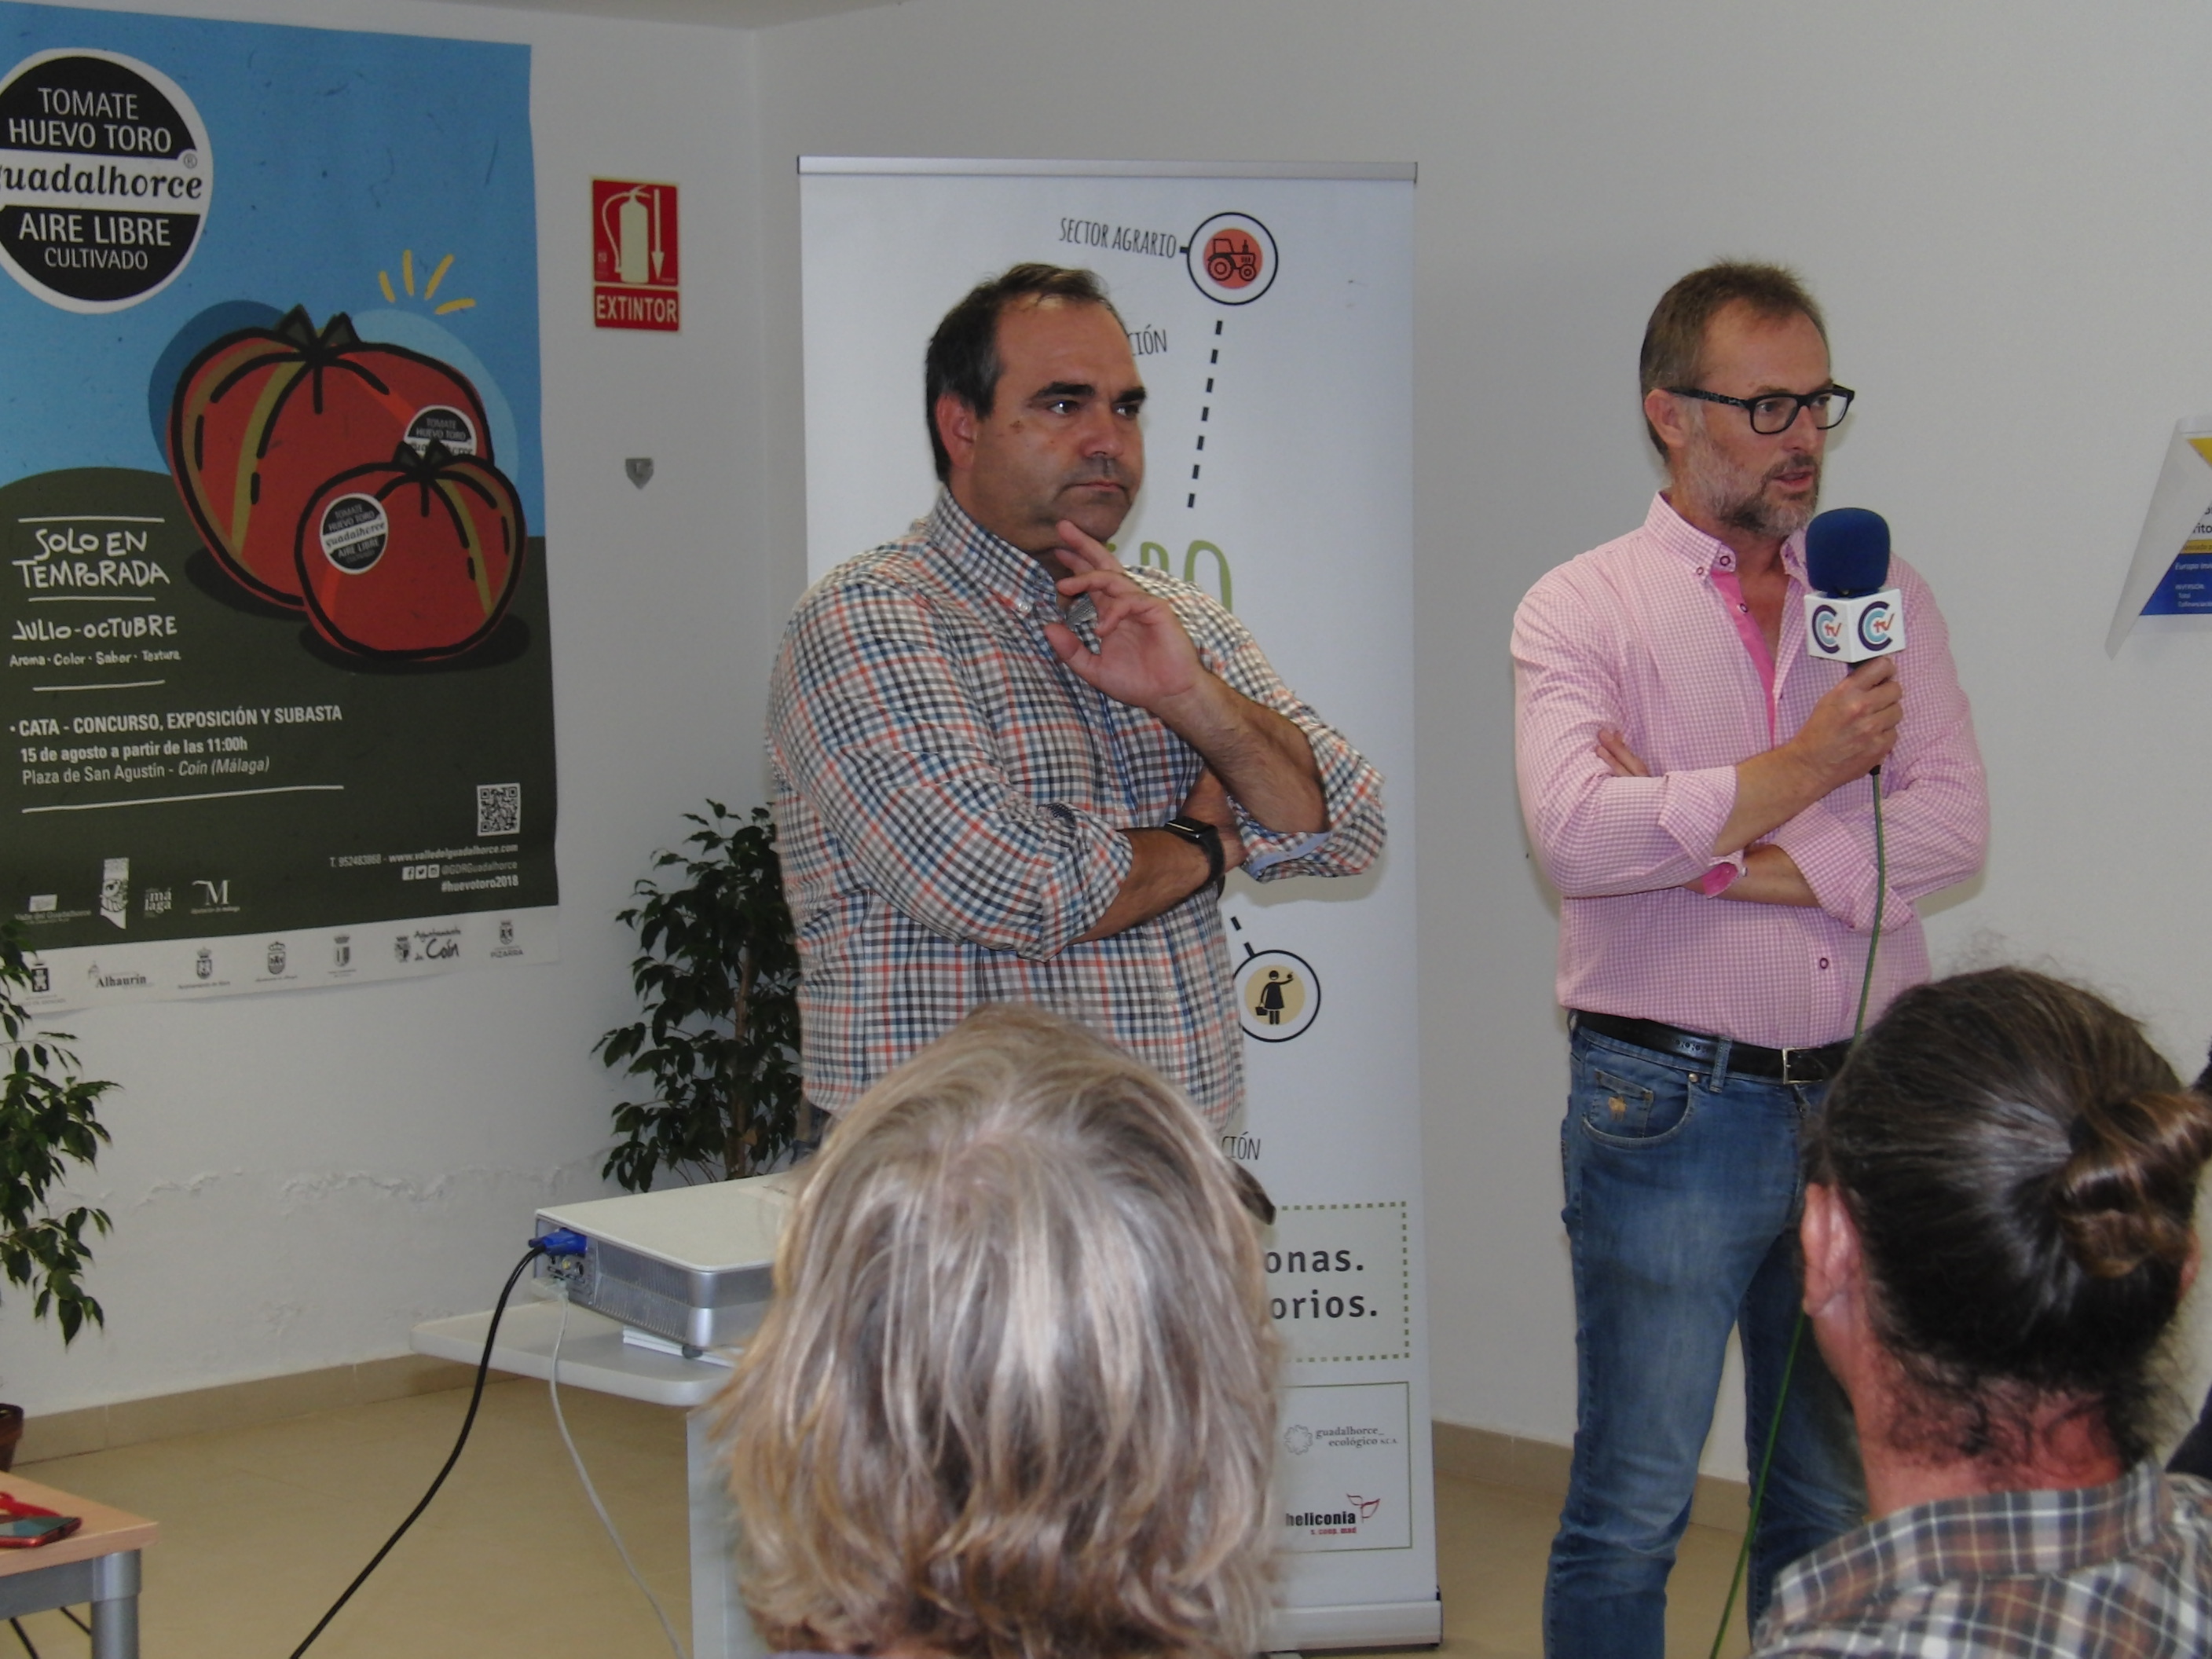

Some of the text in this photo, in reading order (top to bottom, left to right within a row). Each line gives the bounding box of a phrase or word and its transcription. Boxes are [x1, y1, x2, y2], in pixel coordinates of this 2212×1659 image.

[38, 87, 139, 120] TOMATE
[9, 119, 172, 152] HUEVO TORO
[19, 212, 171, 246] AIRE LIBRE
[1059, 218, 1177, 258] SECTOR AGRARIO
[44, 247, 148, 269] CULTIVADO
[595, 295, 677, 323] EXTINTOR
[33, 527, 148, 562] SOLO EN
[12, 560, 170, 588] TEMPORADA
[9, 648, 181, 668] Aroma Color Sabor Textura
[19, 720, 60, 737] CATA
[73, 714, 164, 734] CONCURSO,
[167, 706, 258, 730] EXPOSICIÓN
[261, 709, 271, 724] Y
[274, 705, 342, 725] SUBASTA
[21, 736, 248, 764] 15 de agosto a partir de las 11:00h
[22, 768, 60, 786] Plaza
[64, 767, 82, 783] de
[84, 765, 111, 782] San
[211, 755, 270, 776] (Málaga)
[441, 874, 519, 892] #huevotoro2018
[1328, 1437, 1378, 1448] ecológico
[1286, 1511, 1356, 1526] heliconia
